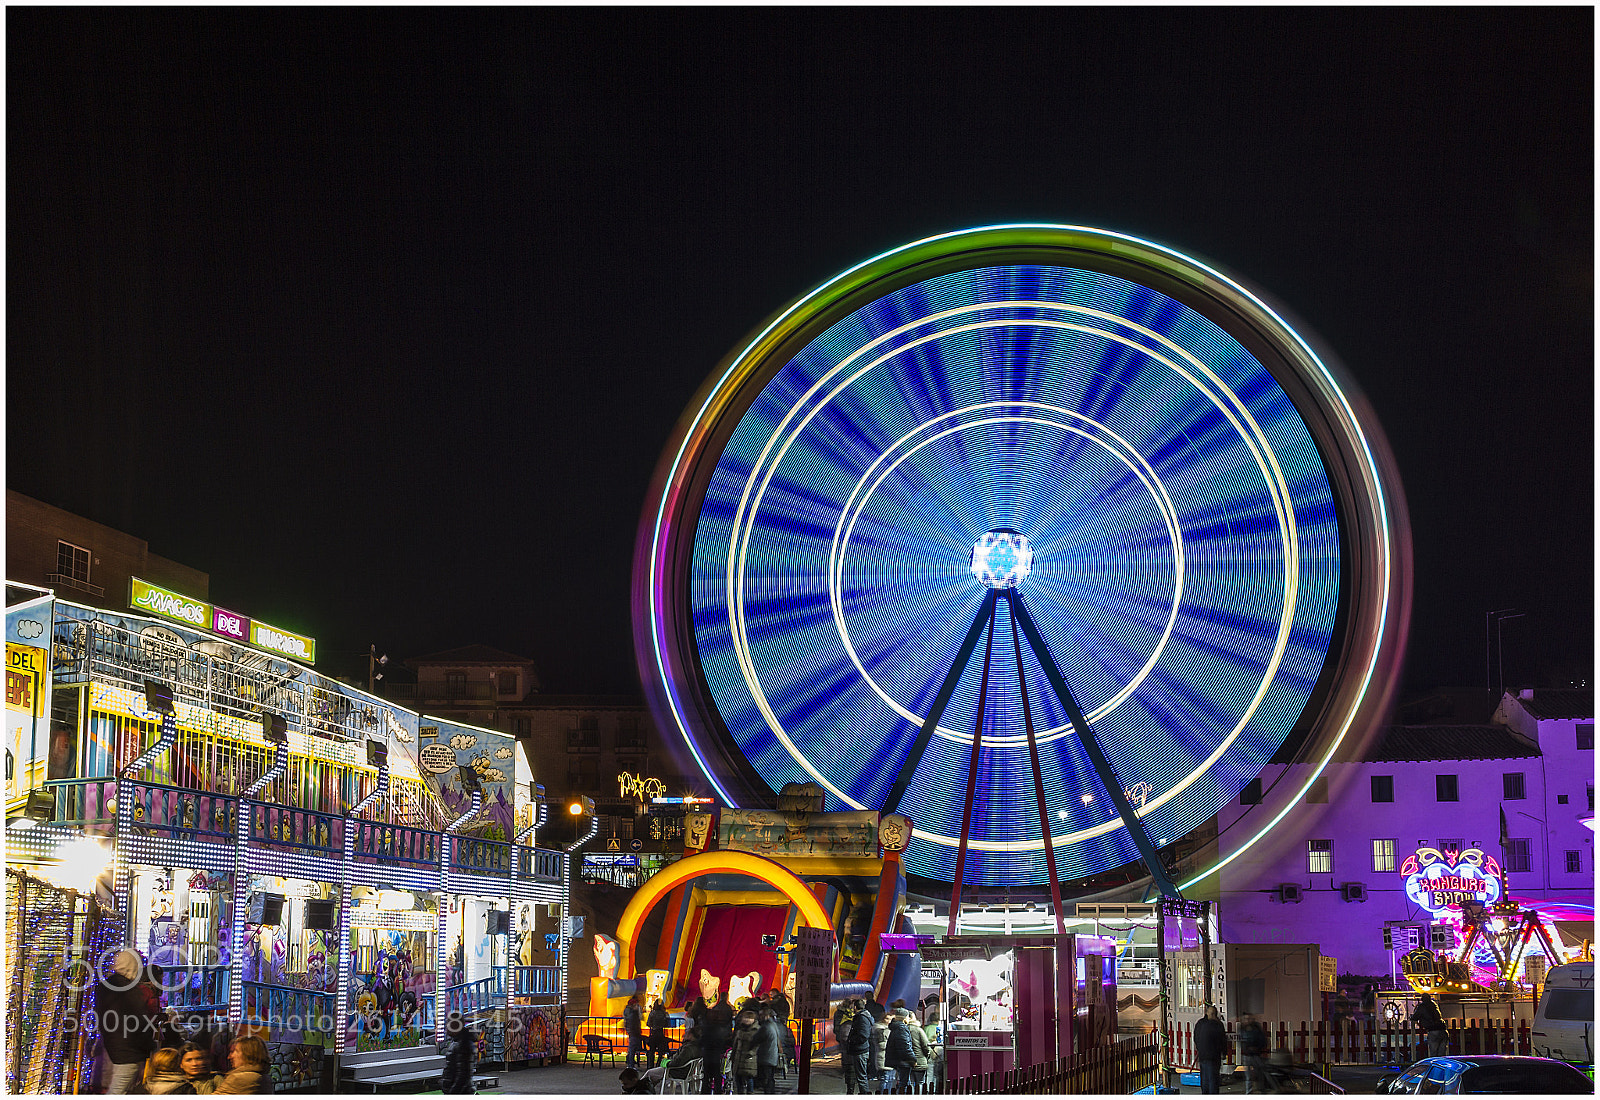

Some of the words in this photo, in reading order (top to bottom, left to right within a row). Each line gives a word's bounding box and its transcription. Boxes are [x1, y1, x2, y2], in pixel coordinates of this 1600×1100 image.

[136, 589, 205, 624] MAGOS
[217, 613, 243, 637] DEL
[12, 651, 36, 670] DEL
[1419, 875, 1487, 893] KANGURO
[1218, 959, 1226, 1022] TAQUILLA
